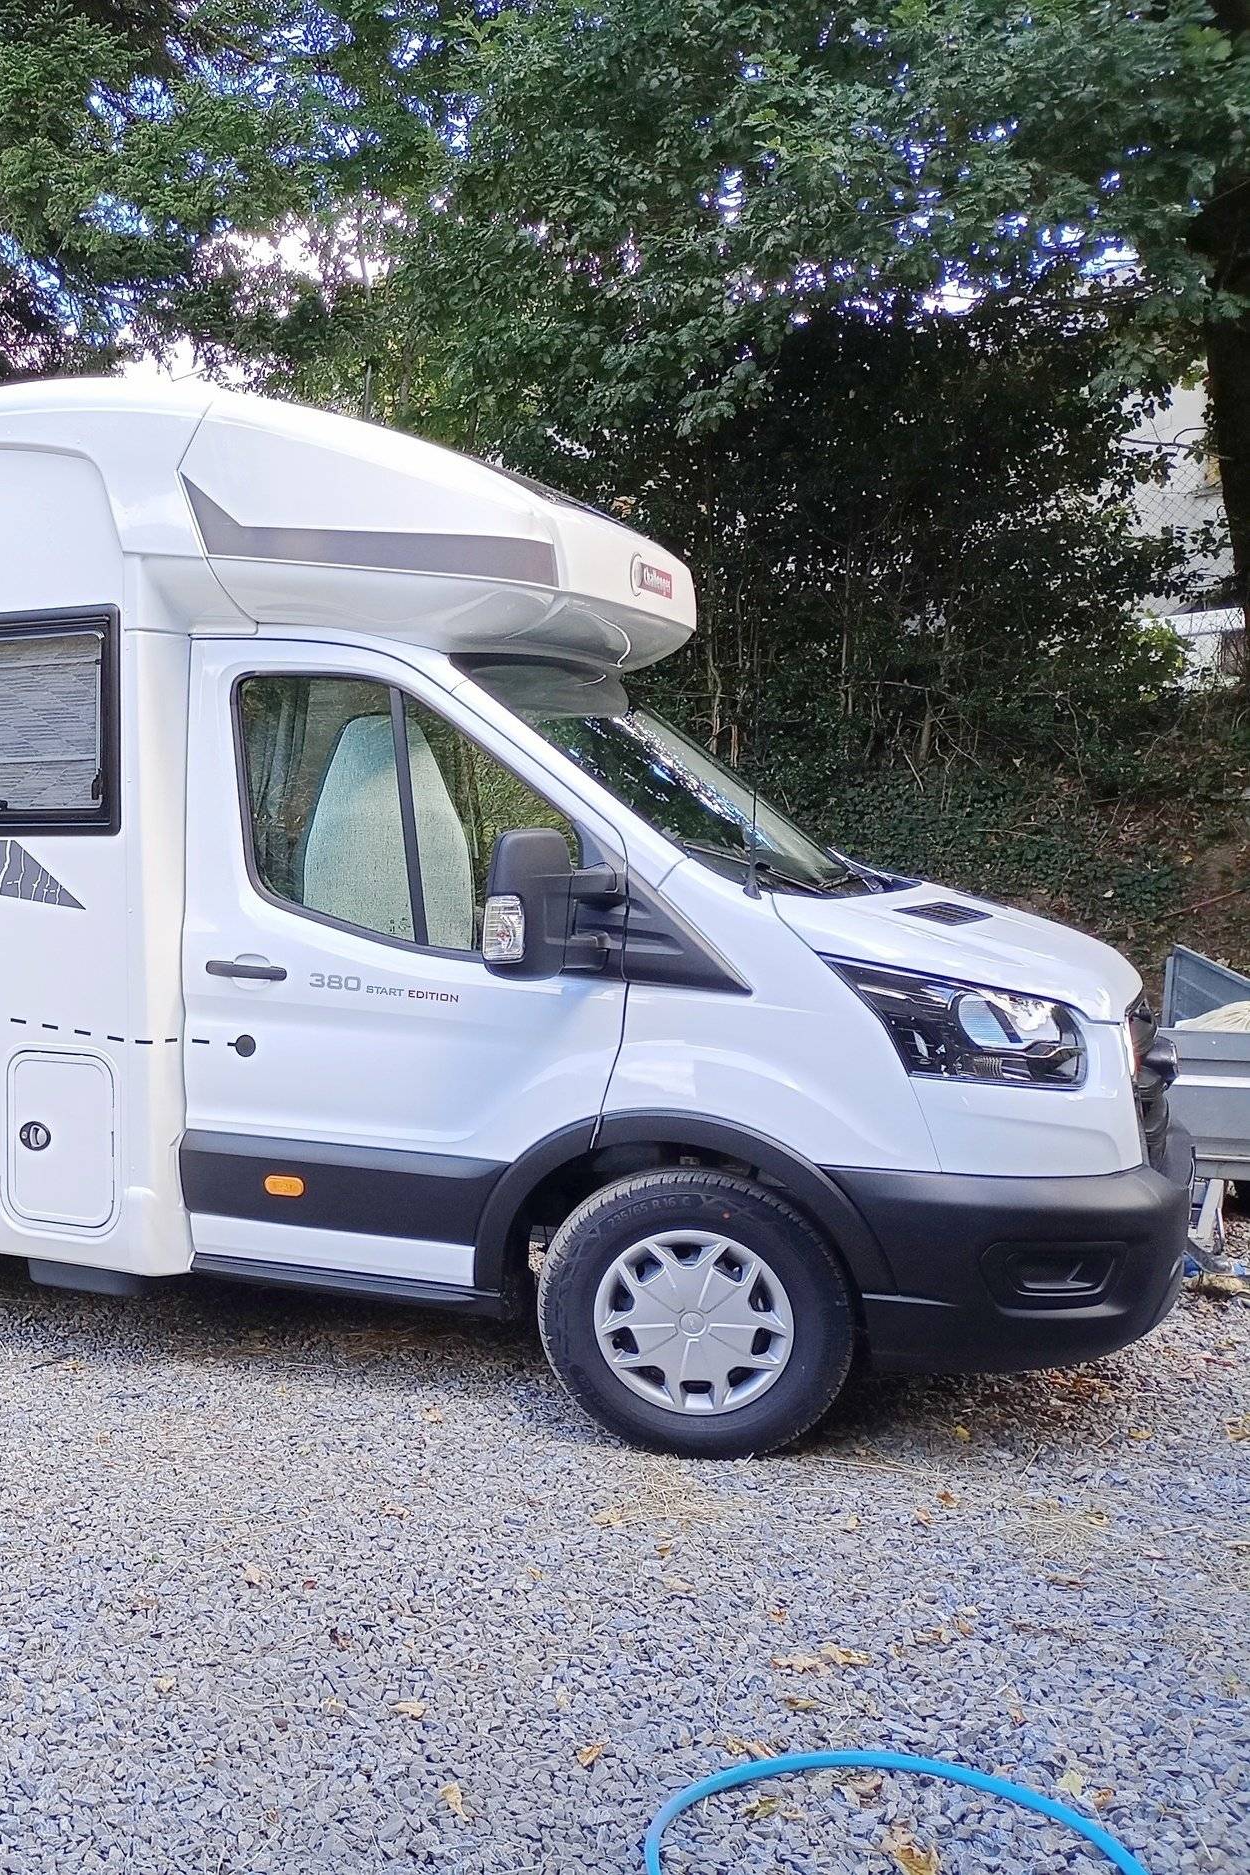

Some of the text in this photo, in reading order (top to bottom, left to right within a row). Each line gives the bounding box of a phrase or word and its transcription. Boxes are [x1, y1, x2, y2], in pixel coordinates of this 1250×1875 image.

[309, 972, 460, 1003] 380 START EDITION
